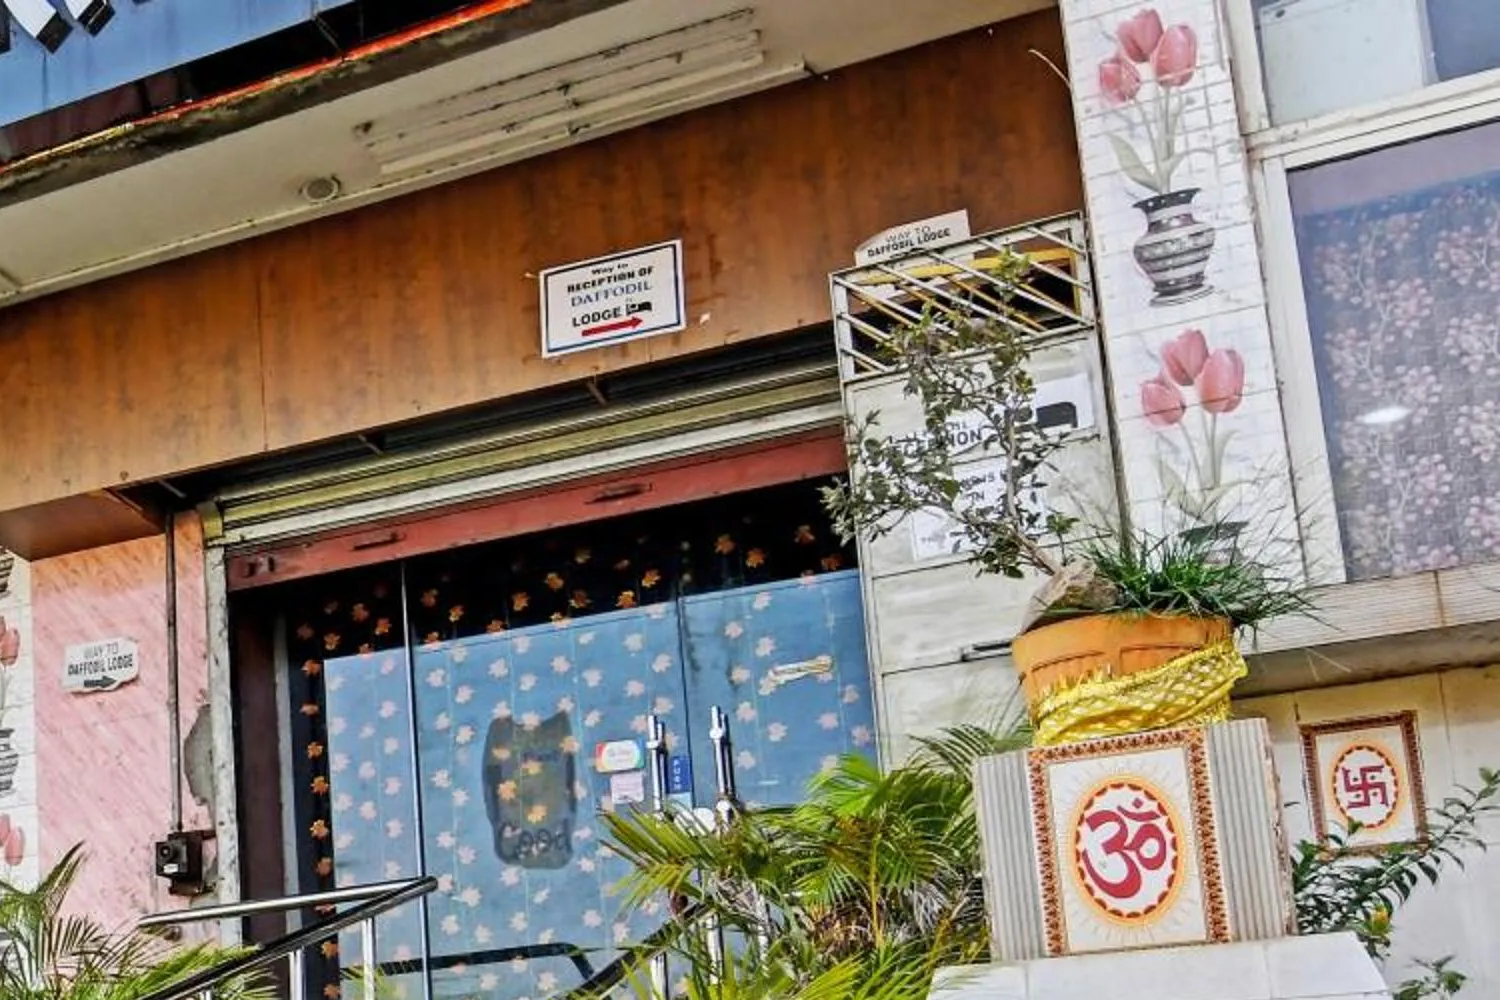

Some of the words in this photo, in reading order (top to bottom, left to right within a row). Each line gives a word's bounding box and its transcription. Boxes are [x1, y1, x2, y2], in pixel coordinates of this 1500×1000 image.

[915, 225, 931, 233] TO
[917, 227, 951, 244] LODGE
[567, 271, 635, 293] RECEPTION
[638, 266, 655, 277] OF
[591, 265, 614, 275] Way
[571, 281, 652, 307] DAFFODIL
[572, 306, 622, 327] LODGE
